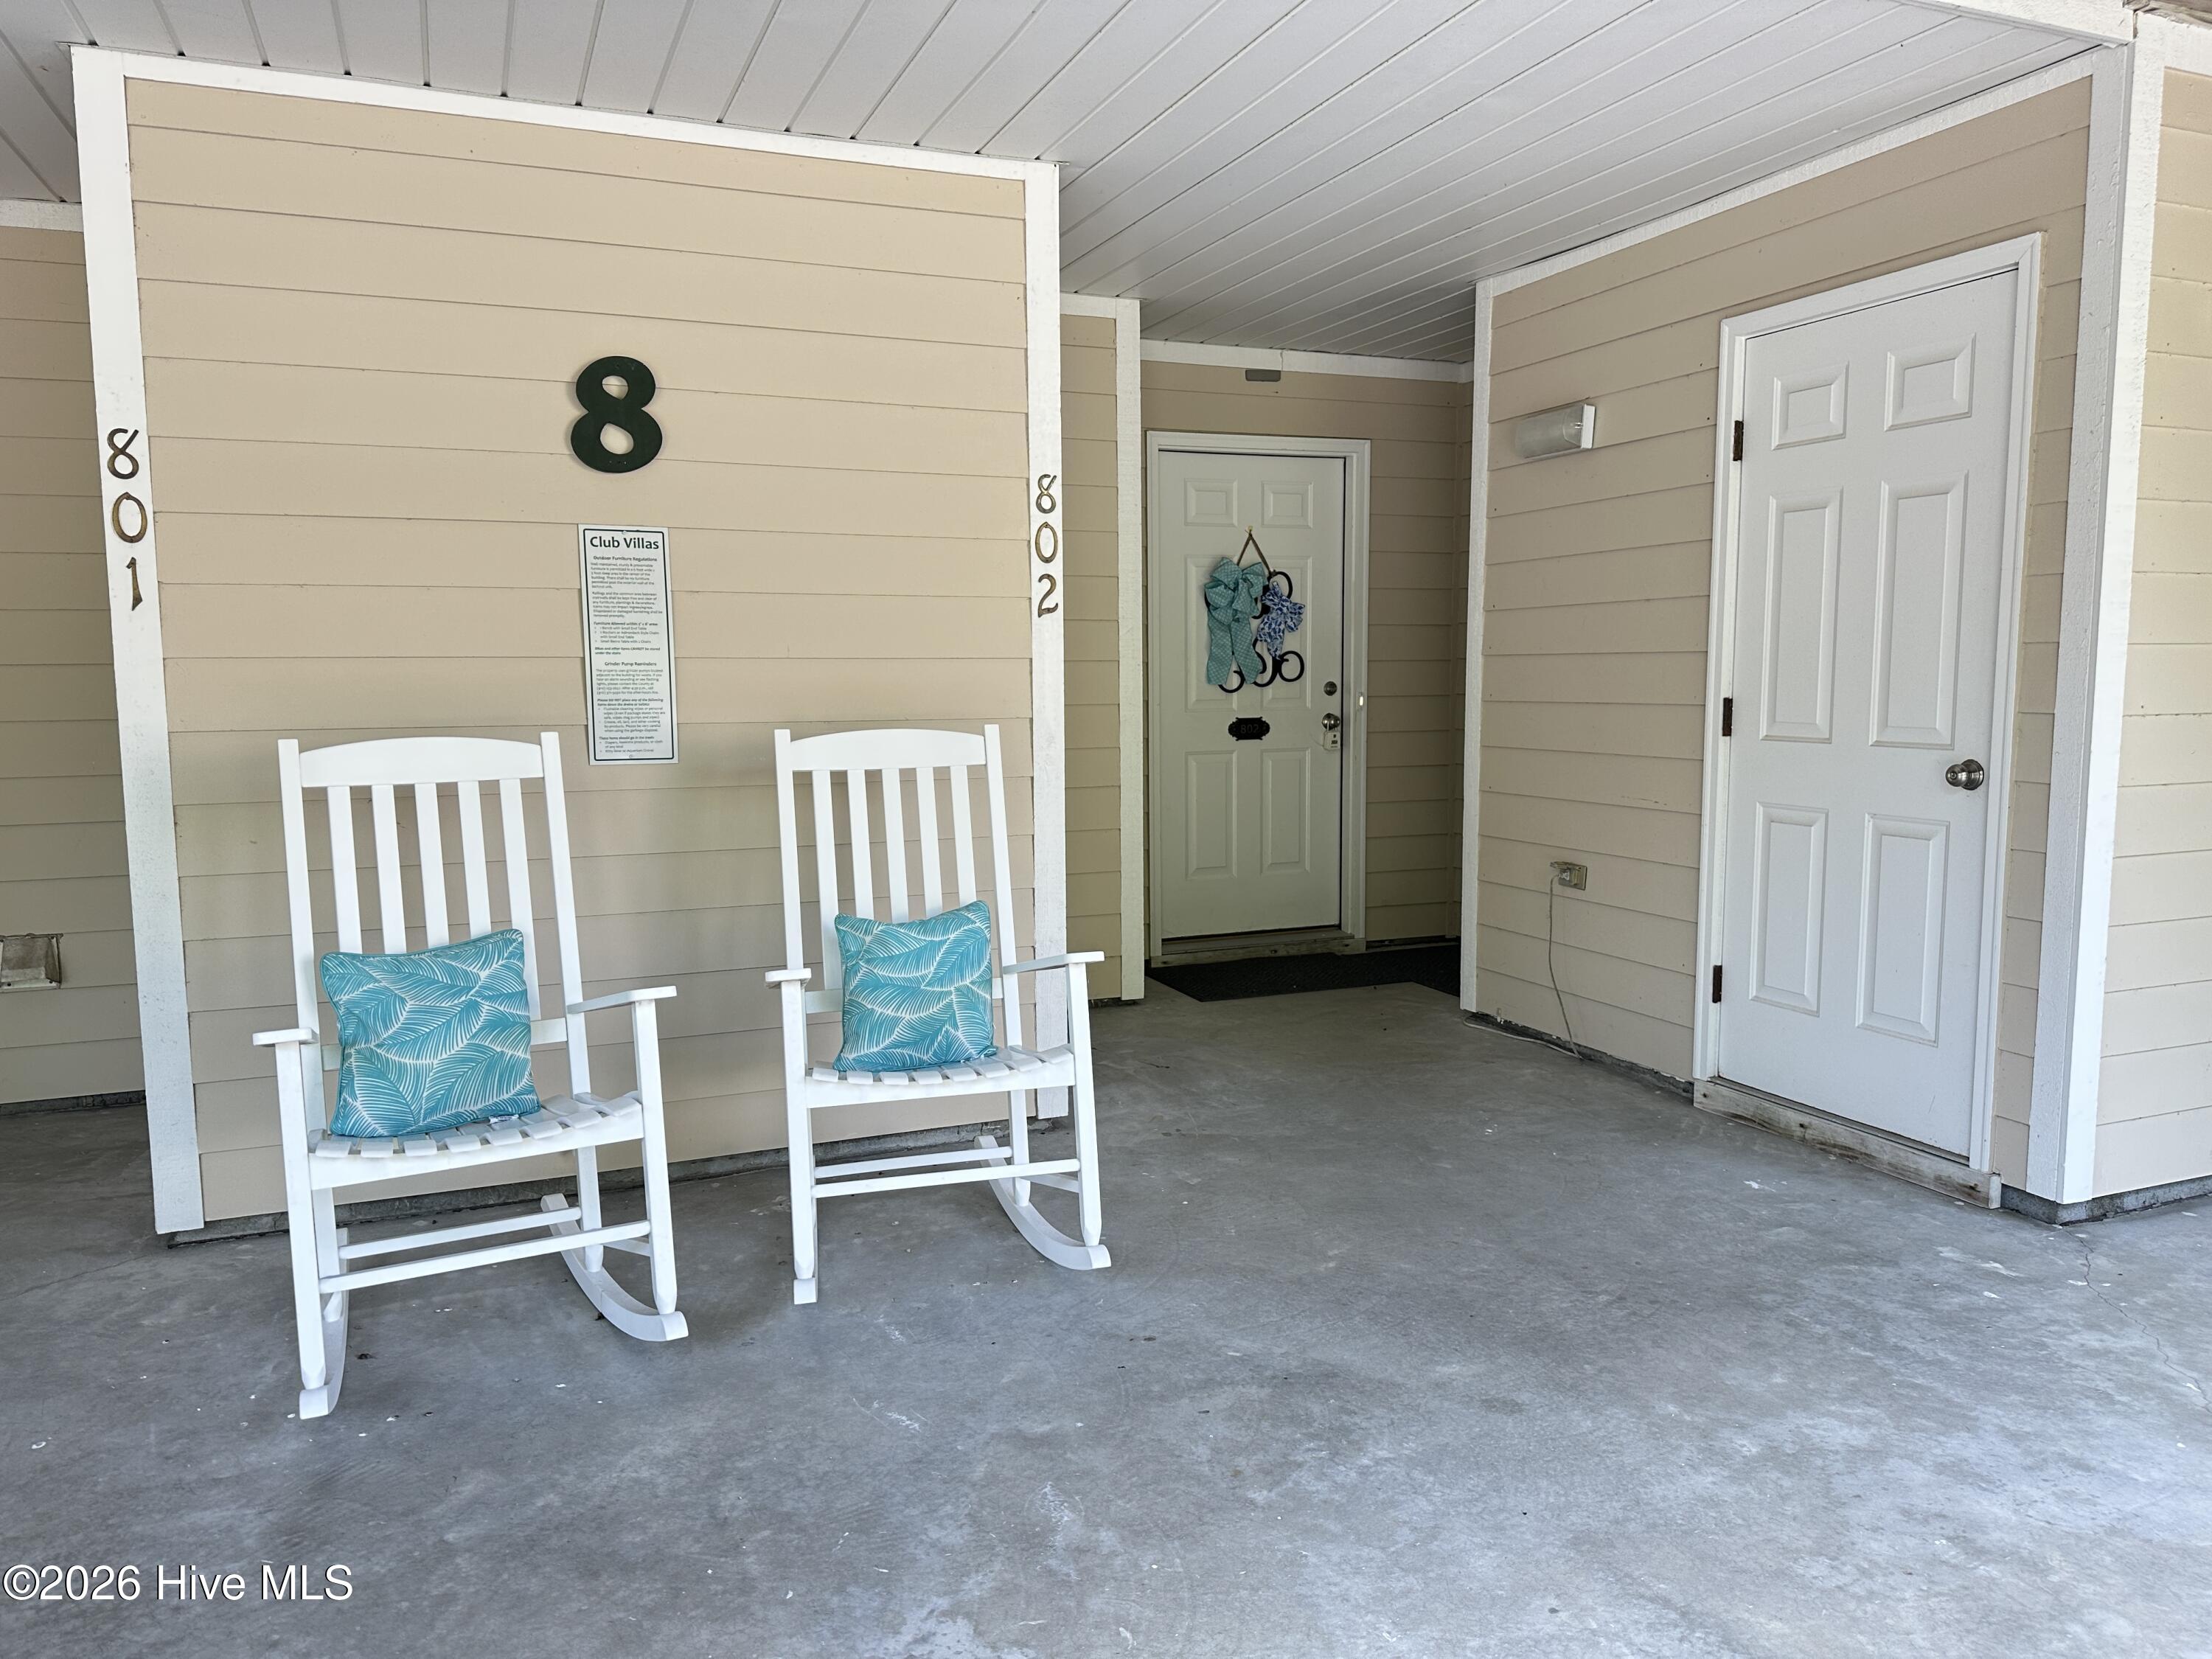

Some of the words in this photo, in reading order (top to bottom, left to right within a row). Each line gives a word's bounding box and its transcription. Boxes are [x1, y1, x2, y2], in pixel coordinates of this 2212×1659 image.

[571, 355, 662, 473] 8
[107, 428, 147, 611] 801
[590, 536, 620, 548] Club
[623, 538, 659, 549] Villas
[1034, 473, 1059, 618] 802
[1240, 724, 1259, 734] 802
